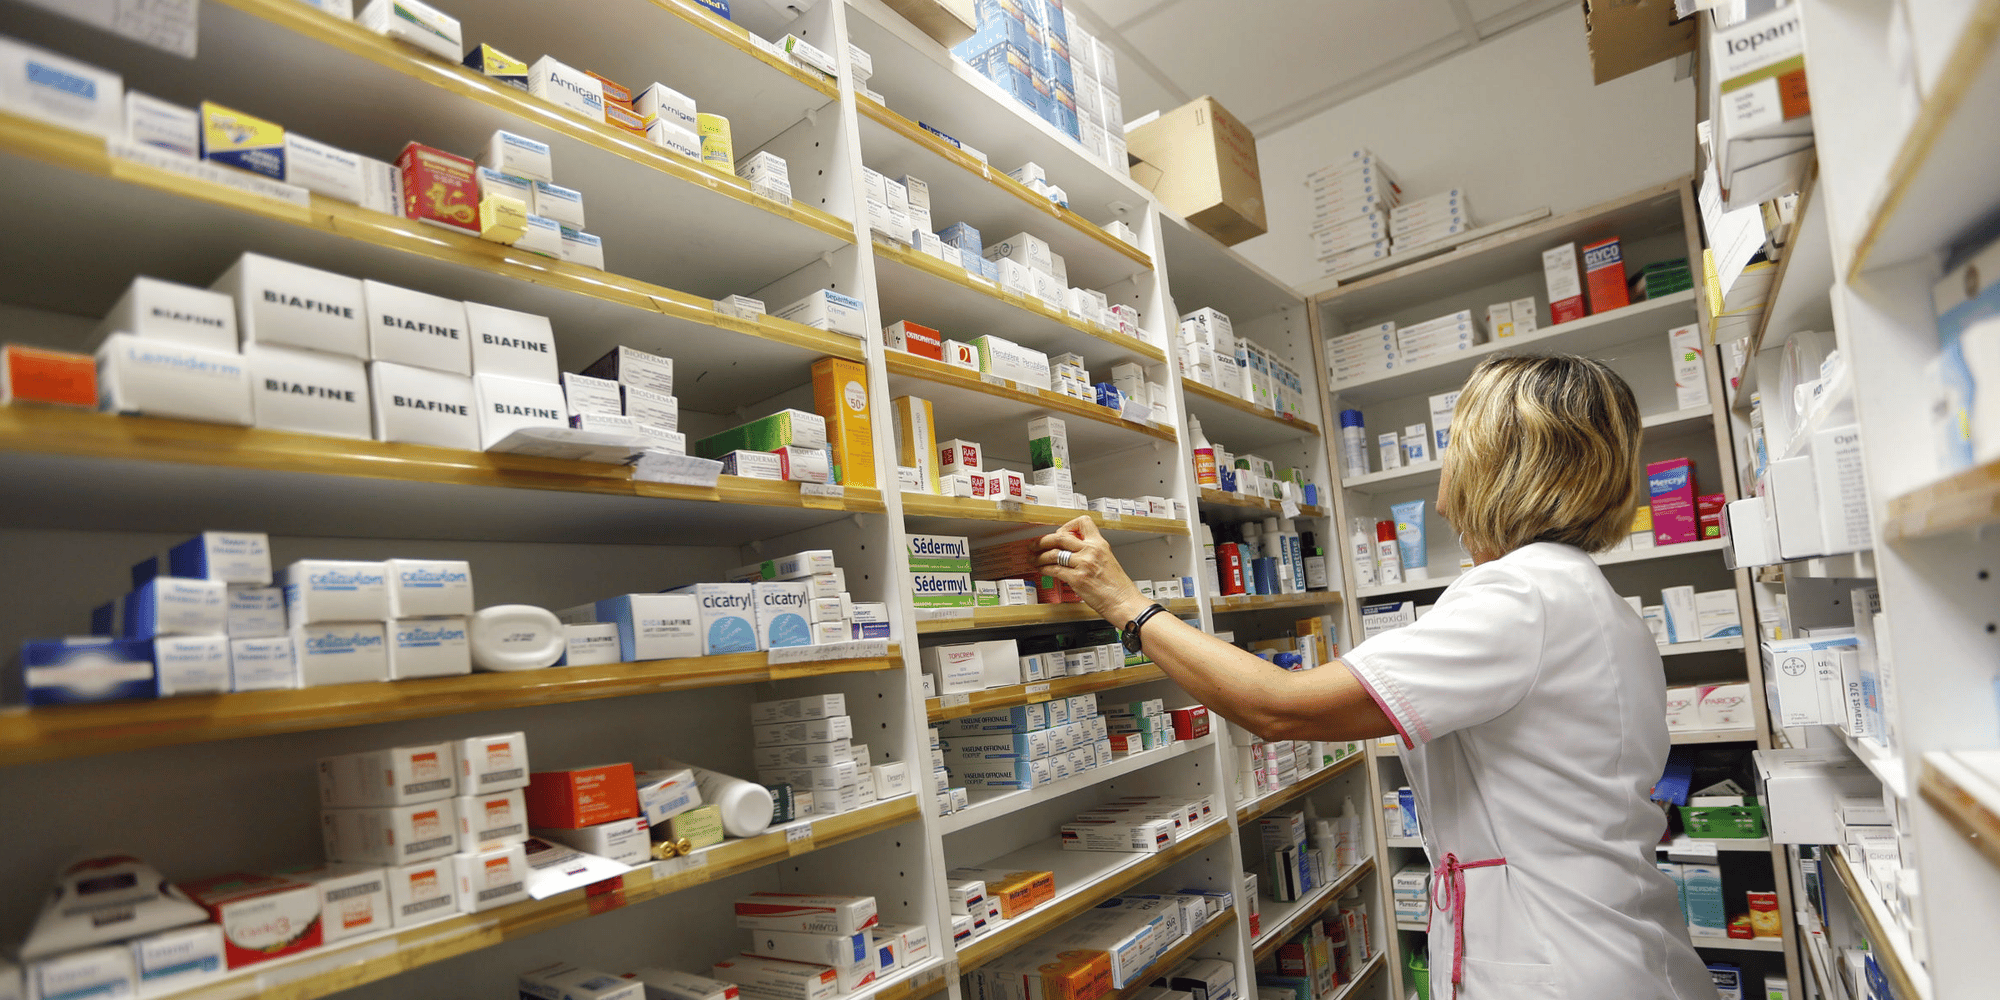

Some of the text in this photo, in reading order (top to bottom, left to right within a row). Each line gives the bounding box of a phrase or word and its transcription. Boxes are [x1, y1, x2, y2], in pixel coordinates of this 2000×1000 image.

[550, 72, 602, 105] Arnican
[661, 102, 697, 124] Arnigel
[666, 139, 702, 160] Arnigel
[1585, 244, 1619, 265] GLYCO
[264, 290, 355, 319] BIAFINE
[151, 306, 225, 328] BIAFINE
[383, 315, 460, 340] BIAFINE
[482, 333, 548, 353] BIAFINE
[623, 349, 670, 367] BIODERMA
[265, 379, 357, 403] BIAFINE
[630, 388, 674, 405] BIODERMA
[393, 395, 469, 416] BIAFINE
[494, 403, 560, 420] BIAFINE
[739, 453, 779, 465] BIODERMA
[963, 447, 976, 459] RAP
[971, 476, 985, 488] RAP
[1009, 477, 1021, 489] RAP
[1650, 475, 1686, 488] Mercryl
[913, 537, 966, 558] Sédermyl
[1289, 537, 1304, 590] biseptine
[915, 575, 968, 595] Sédermyl
[703, 592, 753, 611] cicatryl
[764, 591, 807, 609] cicatryl
[1365, 613, 1408, 626] minoxidil
[1849, 682, 1864, 735] Ultravist 370
[982, 715, 1008, 723] OFFICINALE
[985, 744, 1010, 752] OFFICINALE
[986, 771, 1012, 779] OFFICINALE
